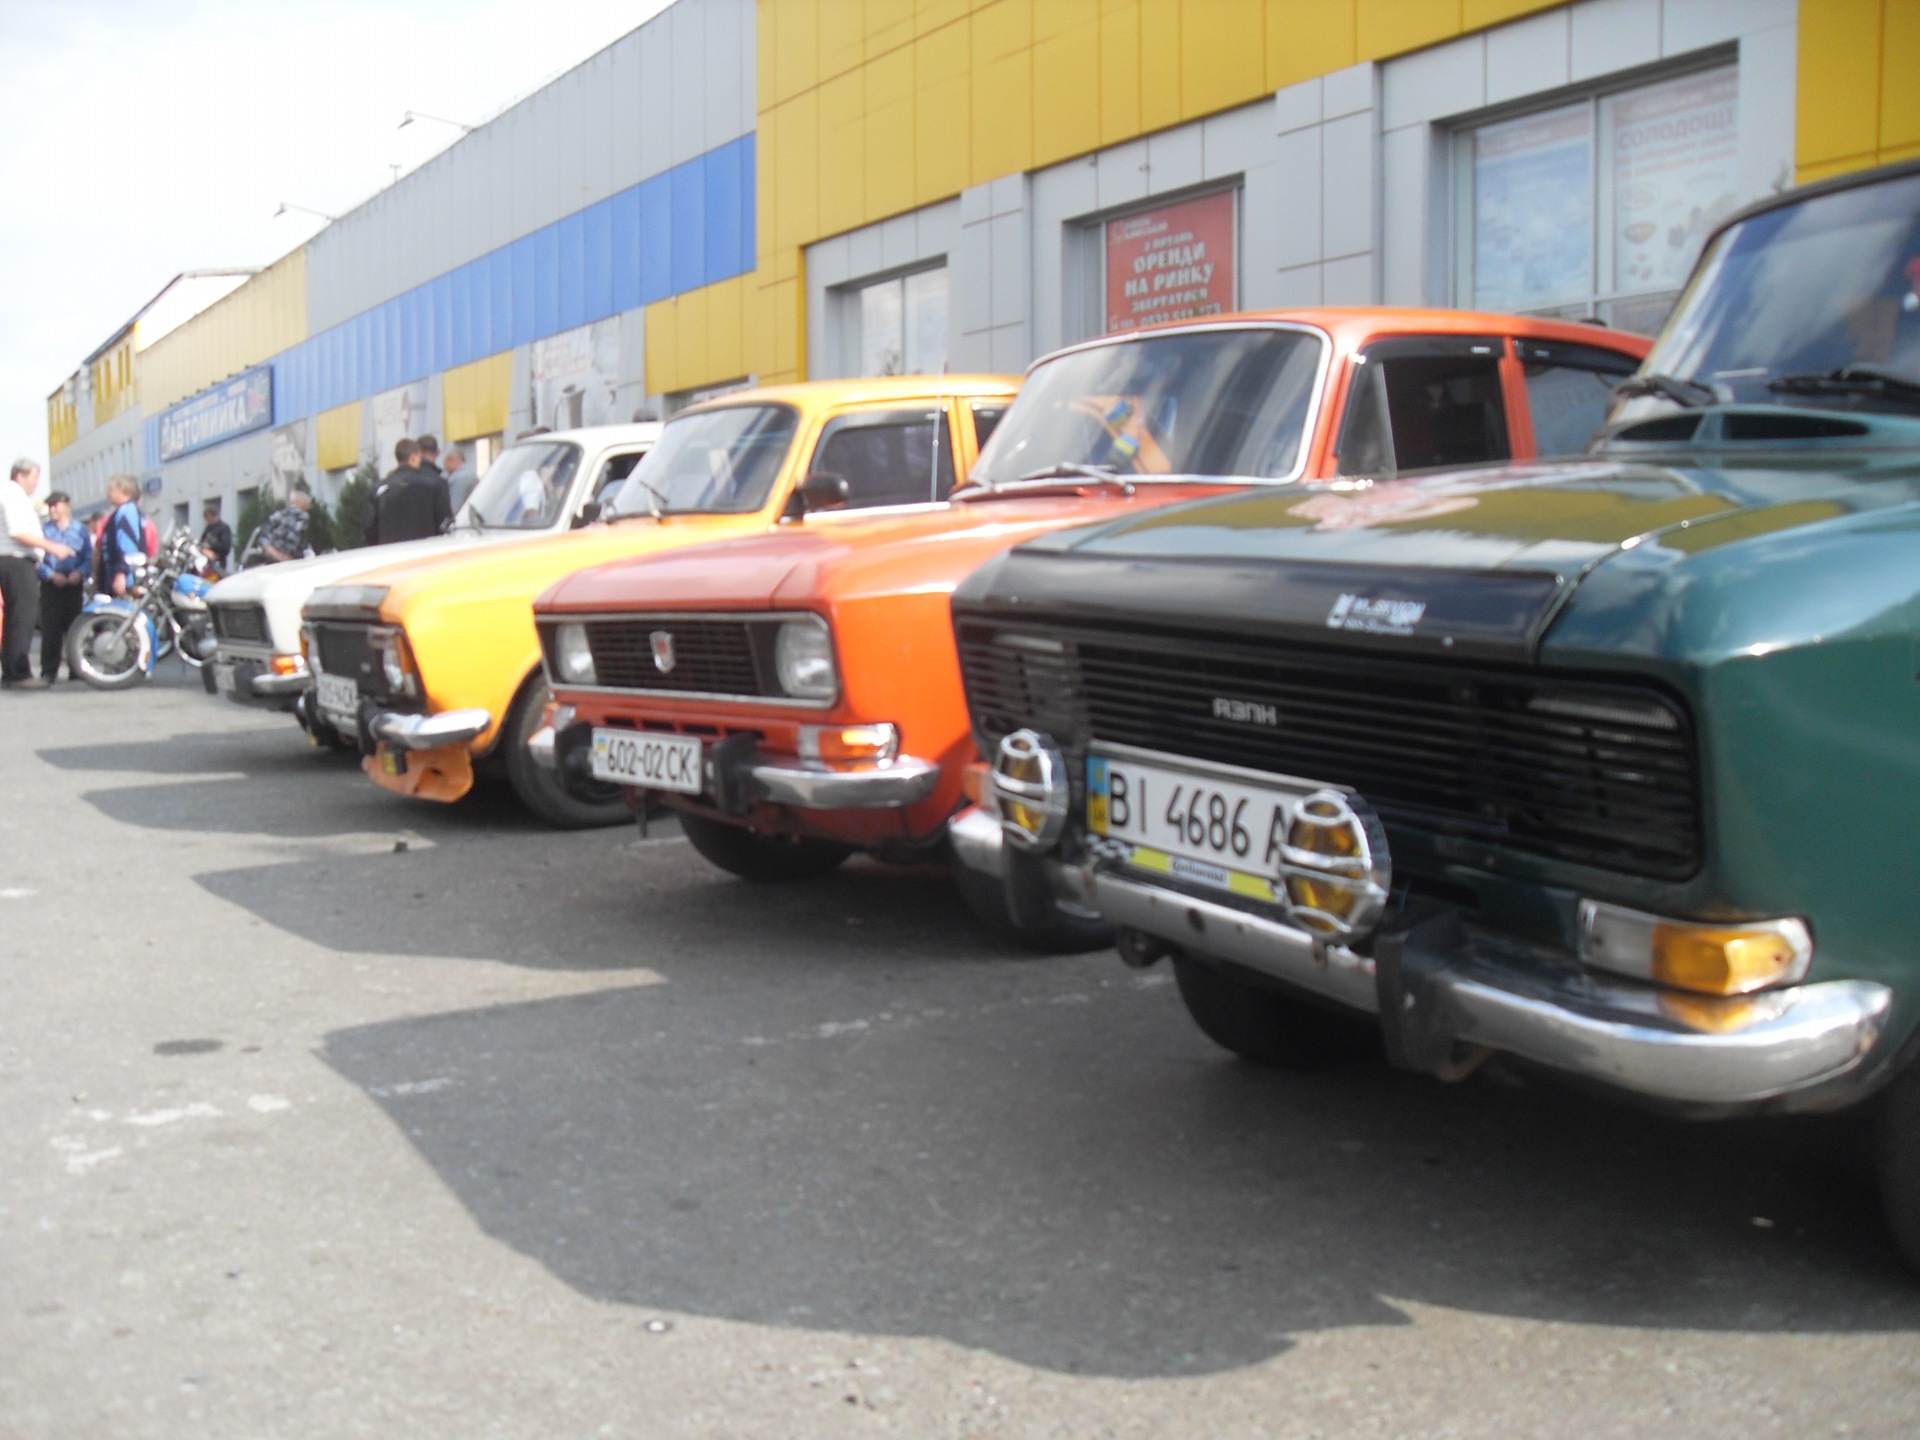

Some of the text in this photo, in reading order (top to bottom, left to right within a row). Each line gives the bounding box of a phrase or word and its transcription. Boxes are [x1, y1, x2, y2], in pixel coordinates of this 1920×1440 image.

[1133, 242, 1205, 273] ОРЕНДИ
[1124, 262, 1214, 297] НА РИНКУ
[1166, 784, 1250, 858] 4686
